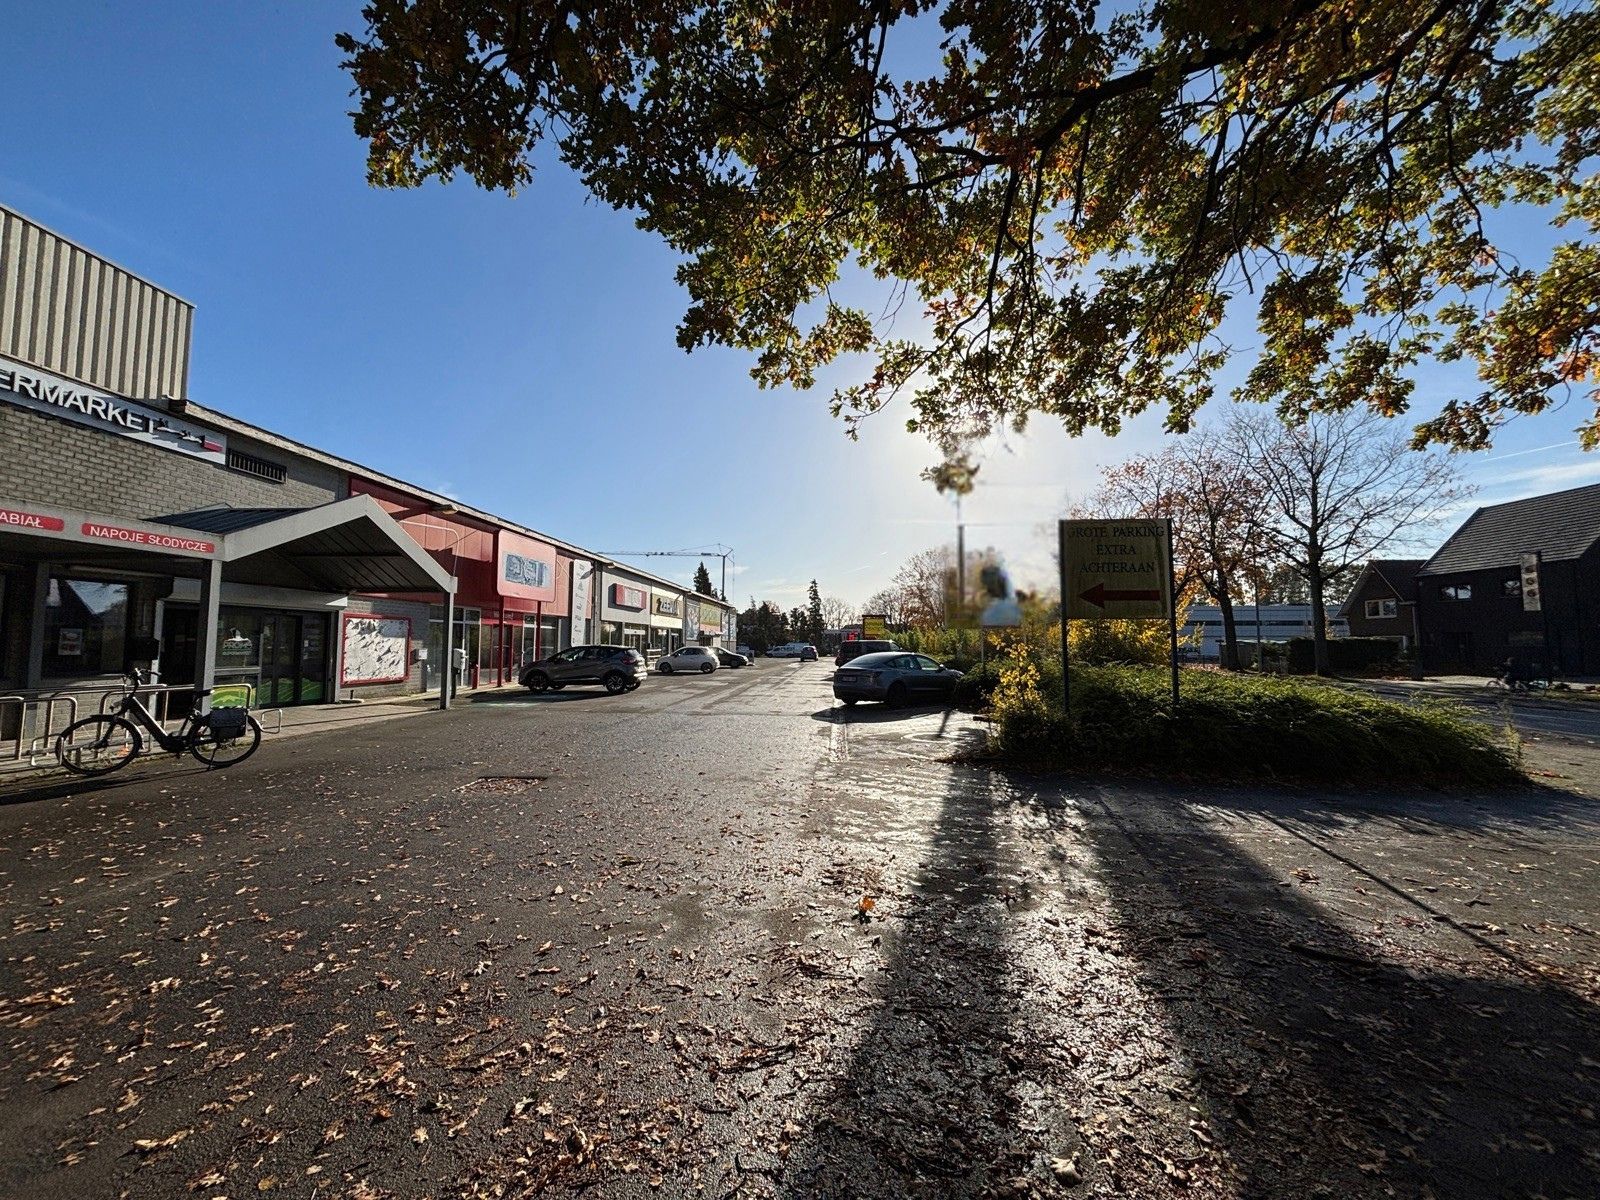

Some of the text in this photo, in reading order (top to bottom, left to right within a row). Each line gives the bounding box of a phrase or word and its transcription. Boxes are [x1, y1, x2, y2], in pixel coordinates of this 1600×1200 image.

[1068, 526, 1165, 538] GROTE PARKING
[90, 526, 207, 552] NAPOJE SŁODYCZE
[1096, 544, 1137, 556] EXTRA
[1081, 561, 1155, 573] ACHTERAAN
